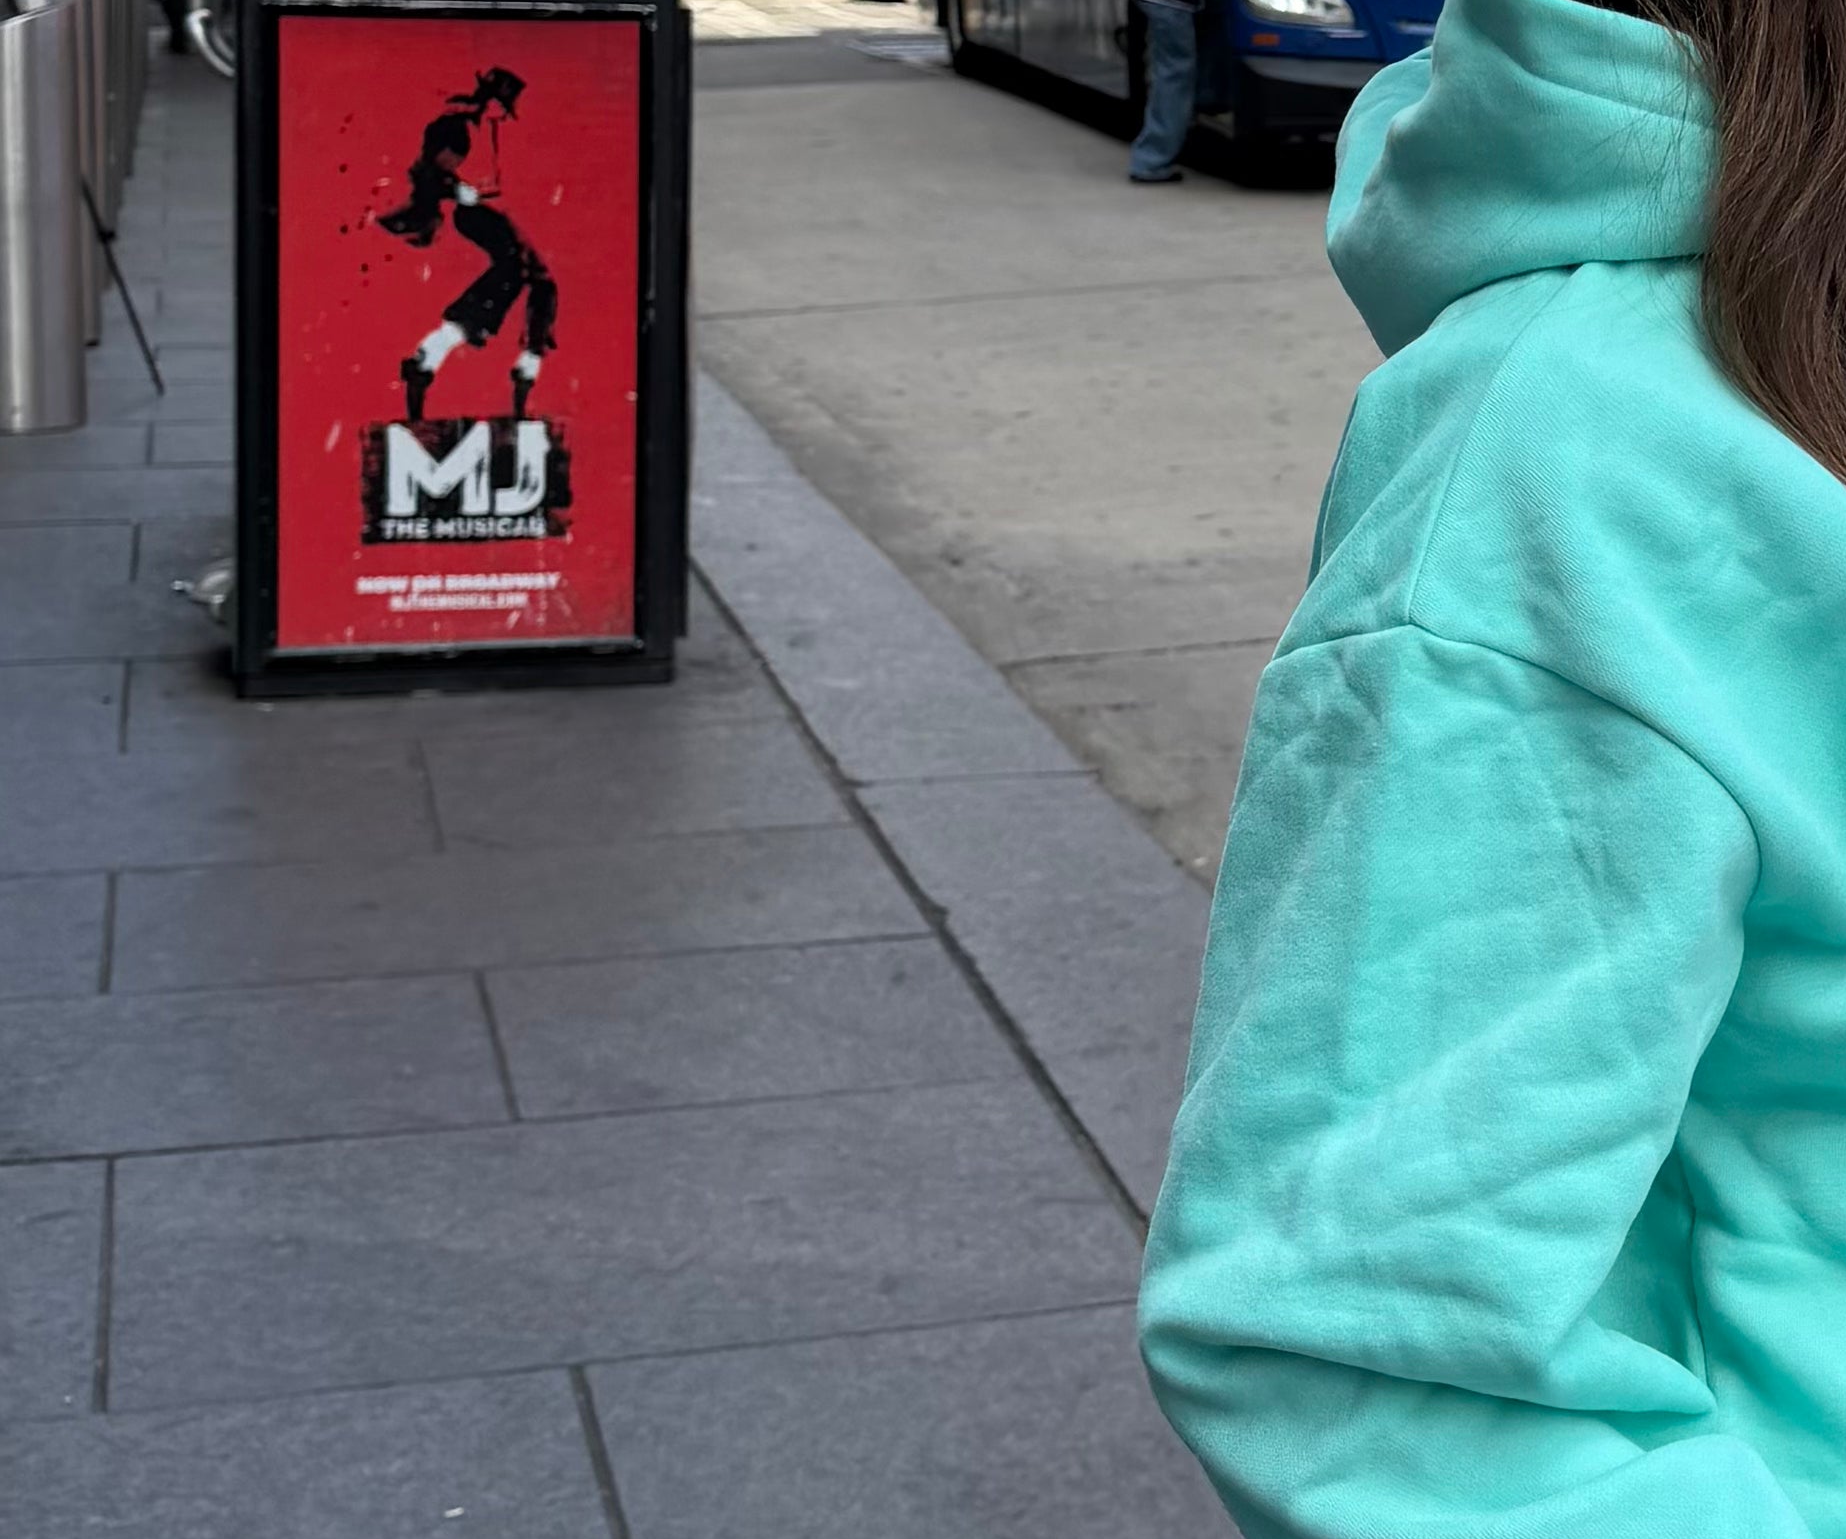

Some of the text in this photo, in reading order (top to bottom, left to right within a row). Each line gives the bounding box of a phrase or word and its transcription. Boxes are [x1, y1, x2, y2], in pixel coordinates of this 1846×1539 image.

[387, 419, 551, 517] MJ
[380, 514, 547, 540] THE MUSICAL
